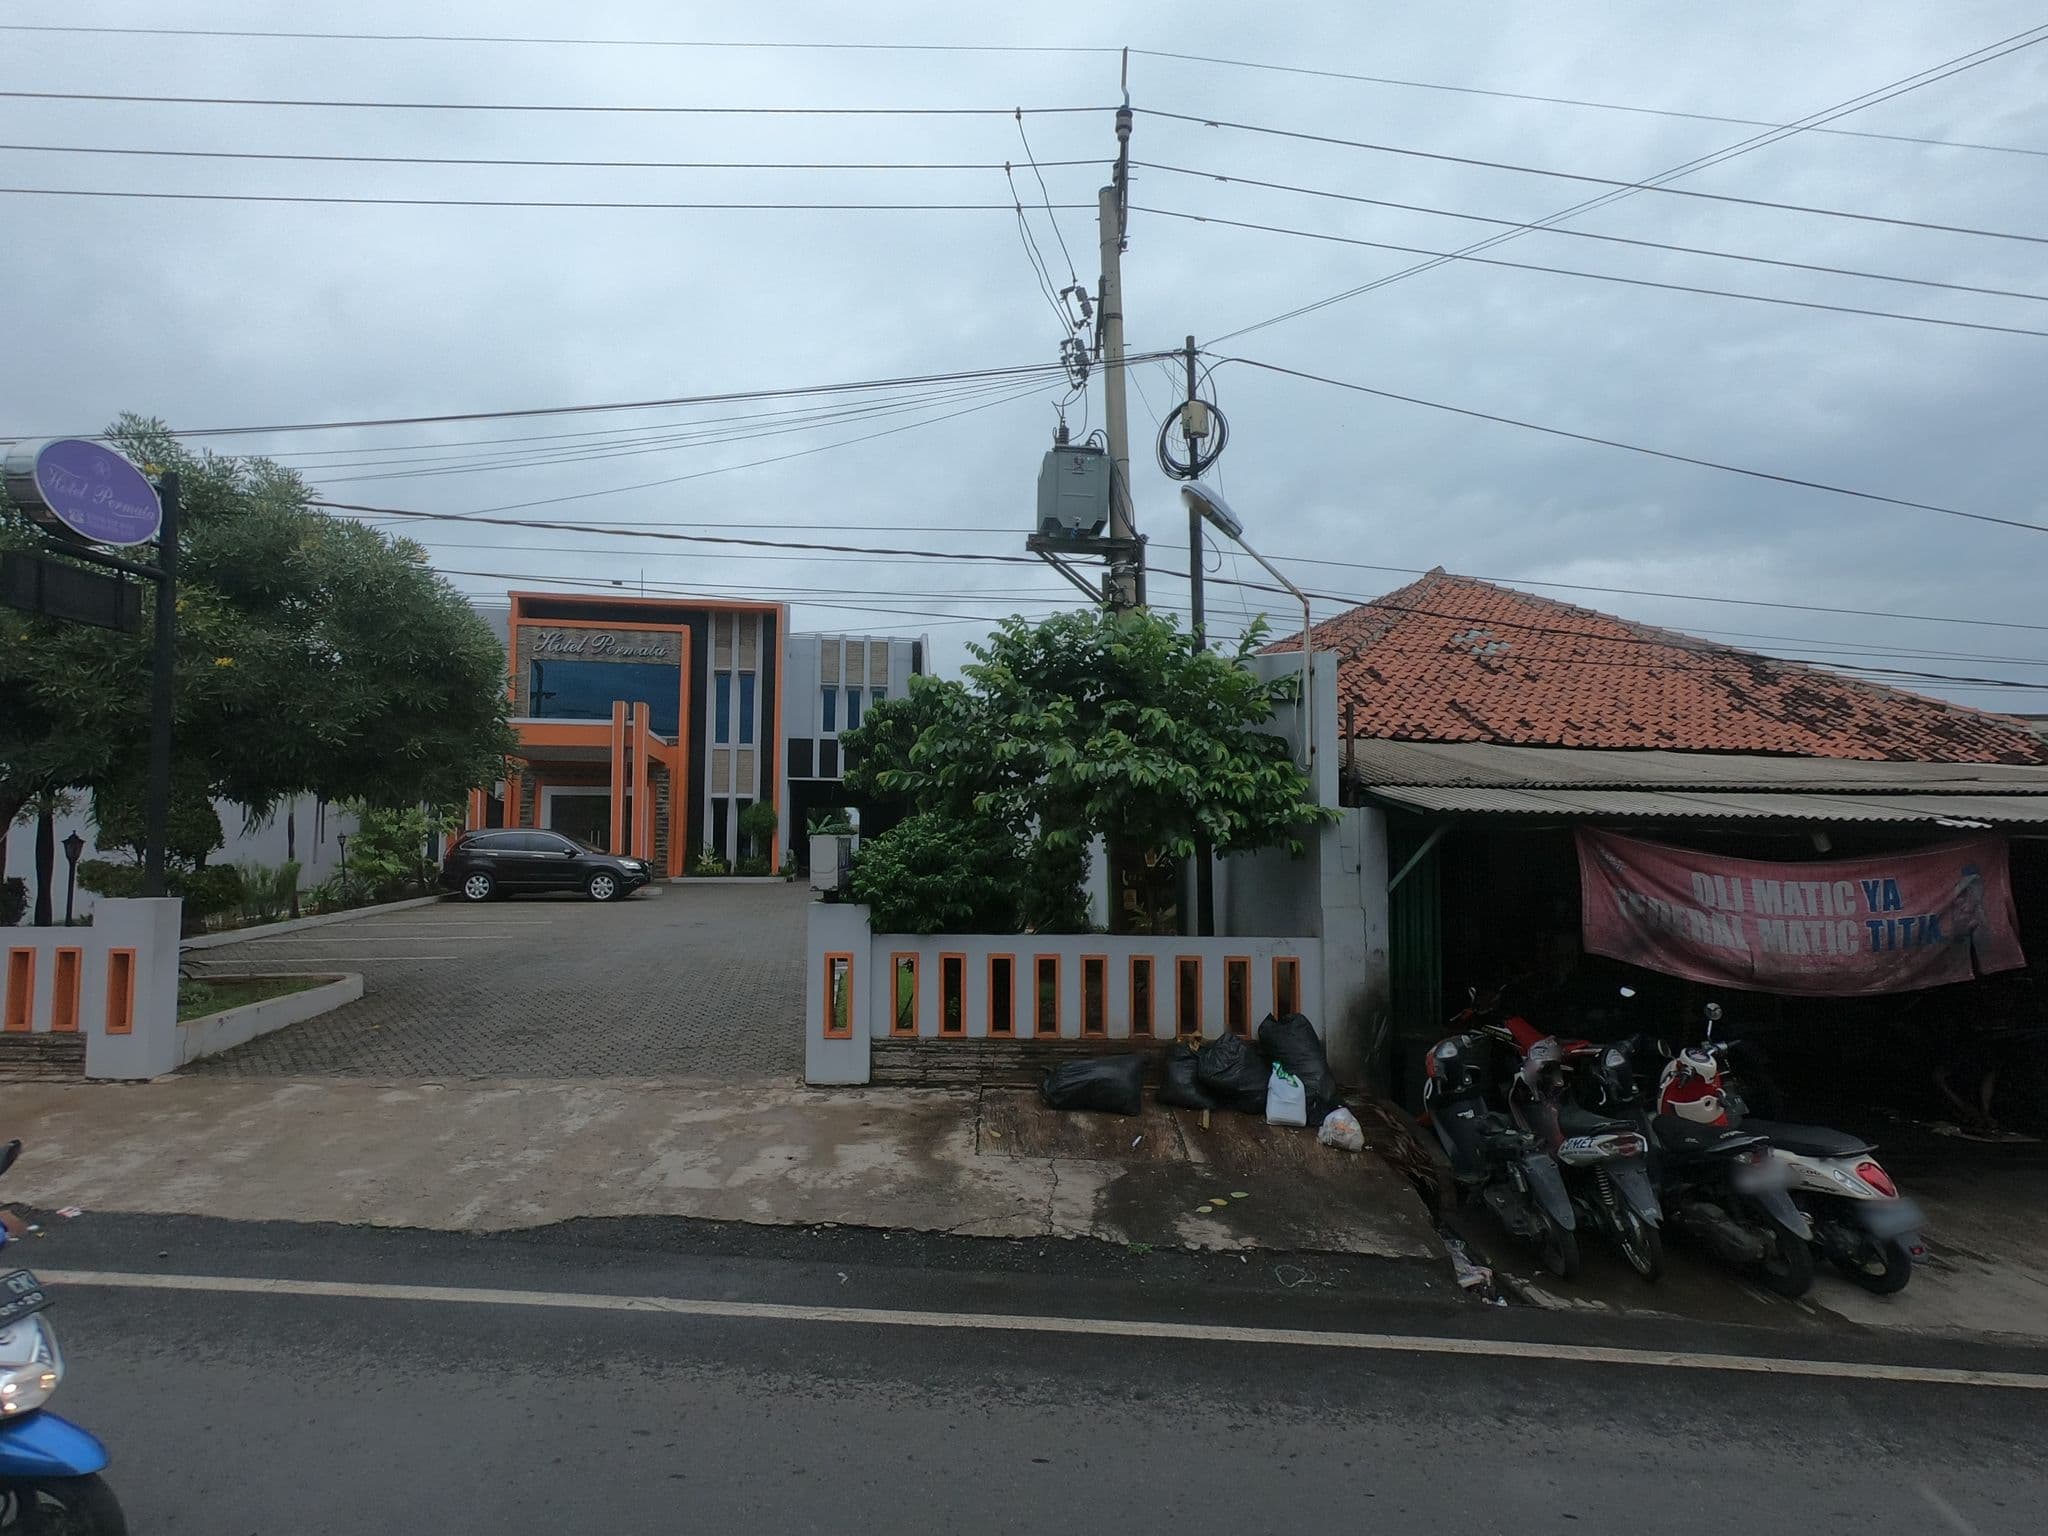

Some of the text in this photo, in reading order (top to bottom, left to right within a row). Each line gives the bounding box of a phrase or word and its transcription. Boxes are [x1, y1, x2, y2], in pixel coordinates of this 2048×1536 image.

[43, 464, 88, 496] Hotel
[533, 631, 667, 657] Hotel Permata
[1691, 870, 1903, 916] OLI MATIC YA
[1757, 918, 1860, 957] MATIC
